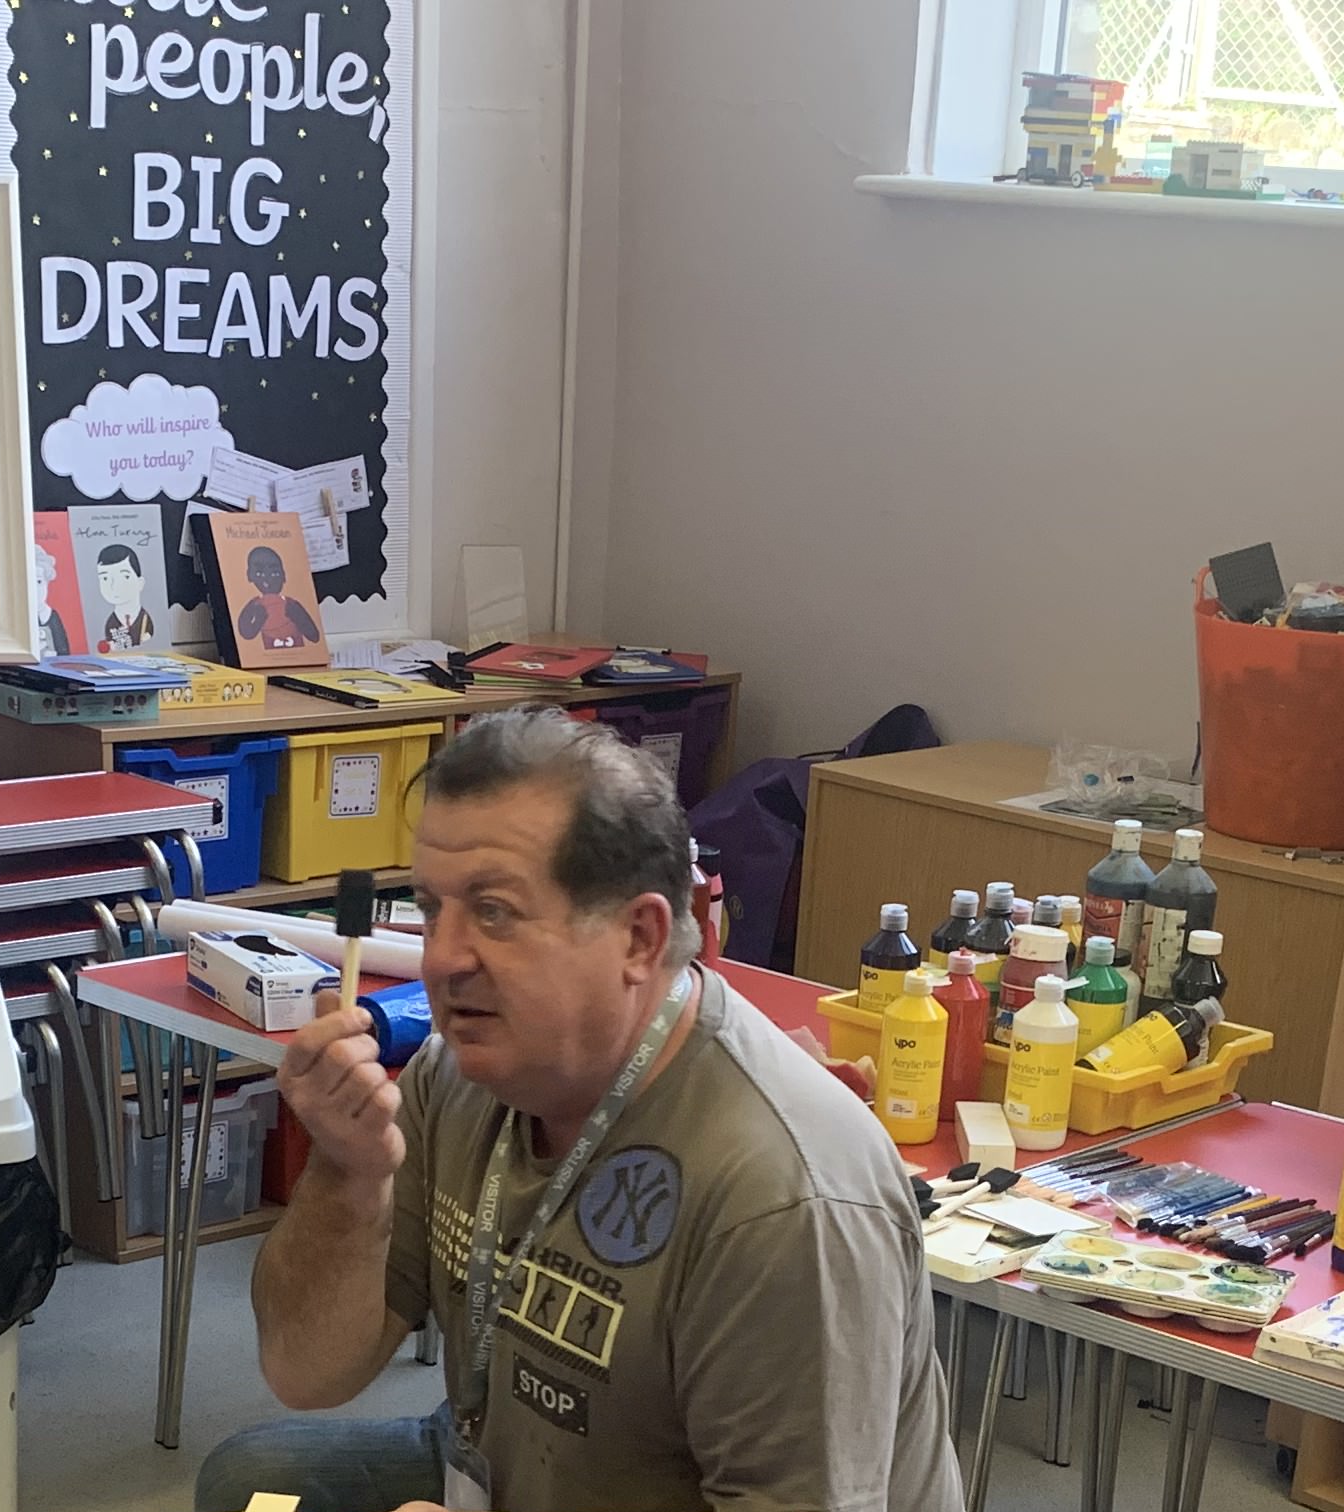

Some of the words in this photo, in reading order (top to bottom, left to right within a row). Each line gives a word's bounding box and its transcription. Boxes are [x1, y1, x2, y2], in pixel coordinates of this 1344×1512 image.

[90, 12, 386, 146] people,
[133, 152, 290, 246] BIG
[40, 256, 380, 362] DREAMS
[85, 418, 123, 439] Who
[126, 417, 157, 436] will
[159, 415, 211, 438] inspire
[109, 457, 141, 477] you
[143, 449, 195, 473] today?
[610, 1042, 655, 1097] VISITOR
[552, 1136, 593, 1191] VISITOR
[479, 1173, 502, 1233] VISITOR
[519, 1369, 575, 1414] STOP
